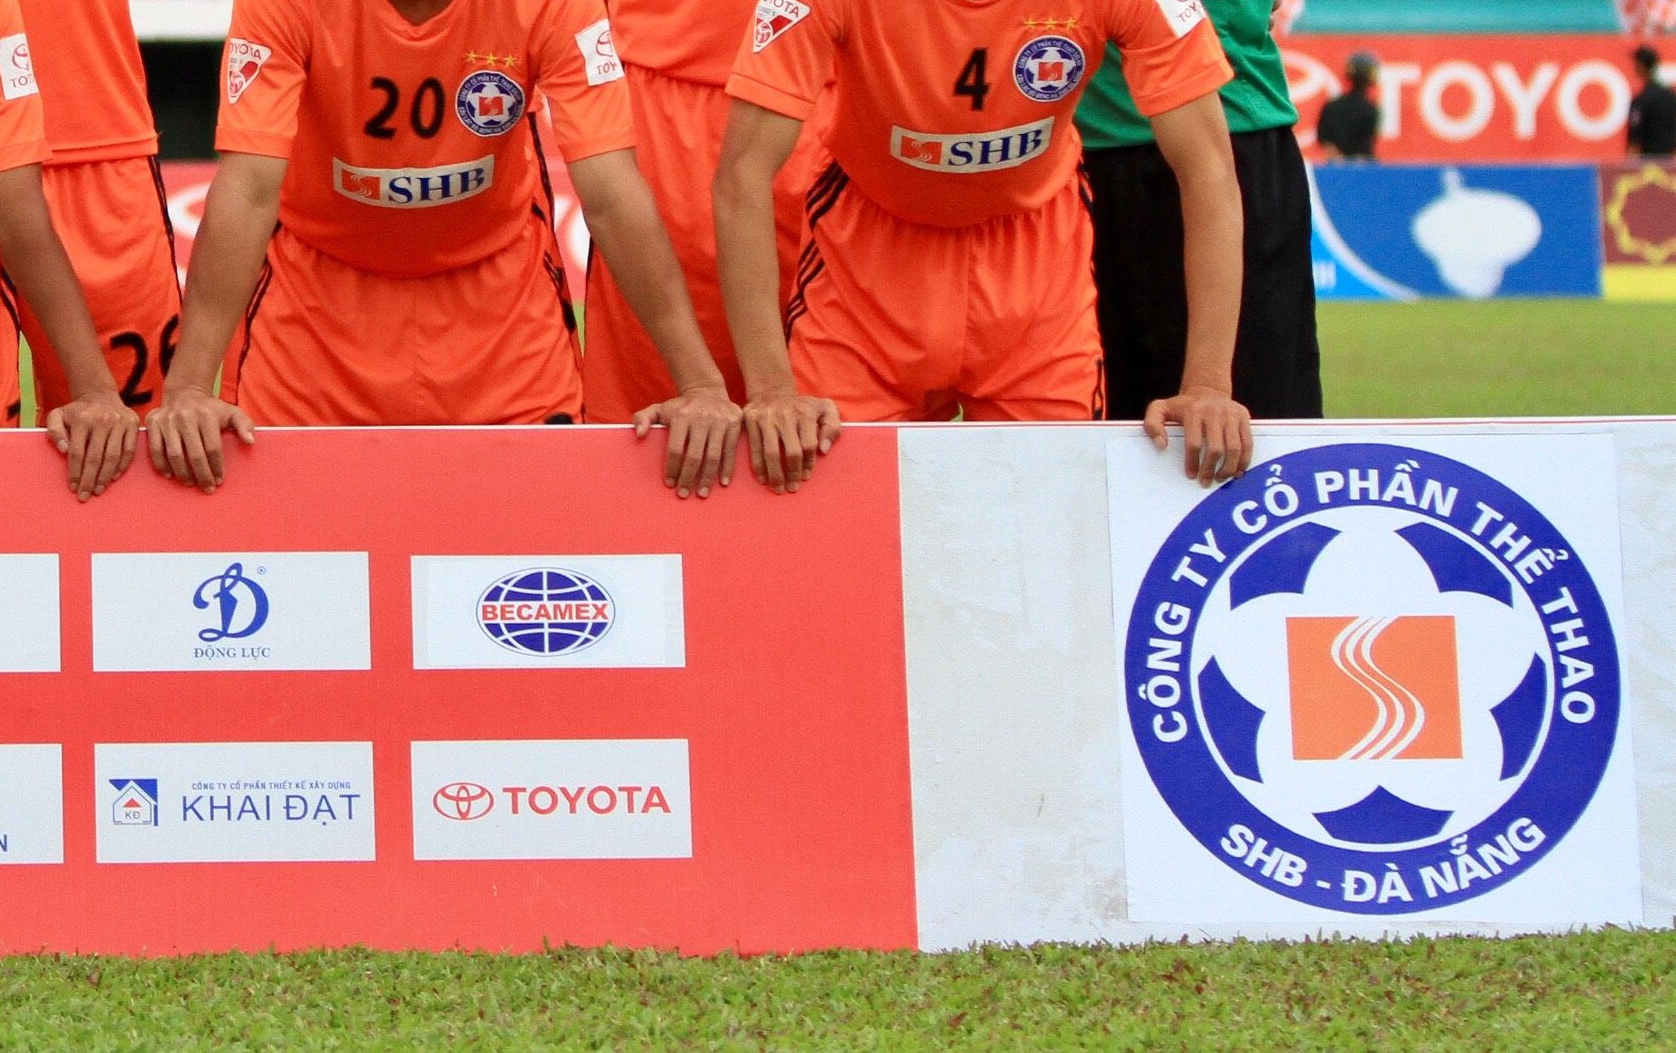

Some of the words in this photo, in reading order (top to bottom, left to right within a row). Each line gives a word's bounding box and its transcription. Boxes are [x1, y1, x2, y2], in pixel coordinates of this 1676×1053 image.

[954, 48, 991, 112] 4
[363, 76, 445, 140] 20
[1378, 60, 1676, 142] TOYO
[948, 128, 1043, 167] SHB
[388, 167, 484, 204] SHB
[481, 602, 609, 622] BECAMEX
[1138, 601, 1191, 743] CÔNG
[1172, 528, 1228, 589] TY
[1231, 464, 1299, 535] CỔ
[1314, 459, 1459, 516] PHẦN
[1473, 501, 1569, 585] THỂ
[1541, 587, 1597, 725] THAO
[194, 644, 236, 660] ĐỘNG
[218, 782, 227, 790] TY
[502, 785, 671, 815] TOYOTA
[182, 794, 270, 821] KHAI
[283, 794, 360, 826] ĐẠT
[1221, 823, 1308, 888] SHB
[1341, 861, 1413, 904] ĐÀ
[1419, 816, 1546, 898] NẴNG
